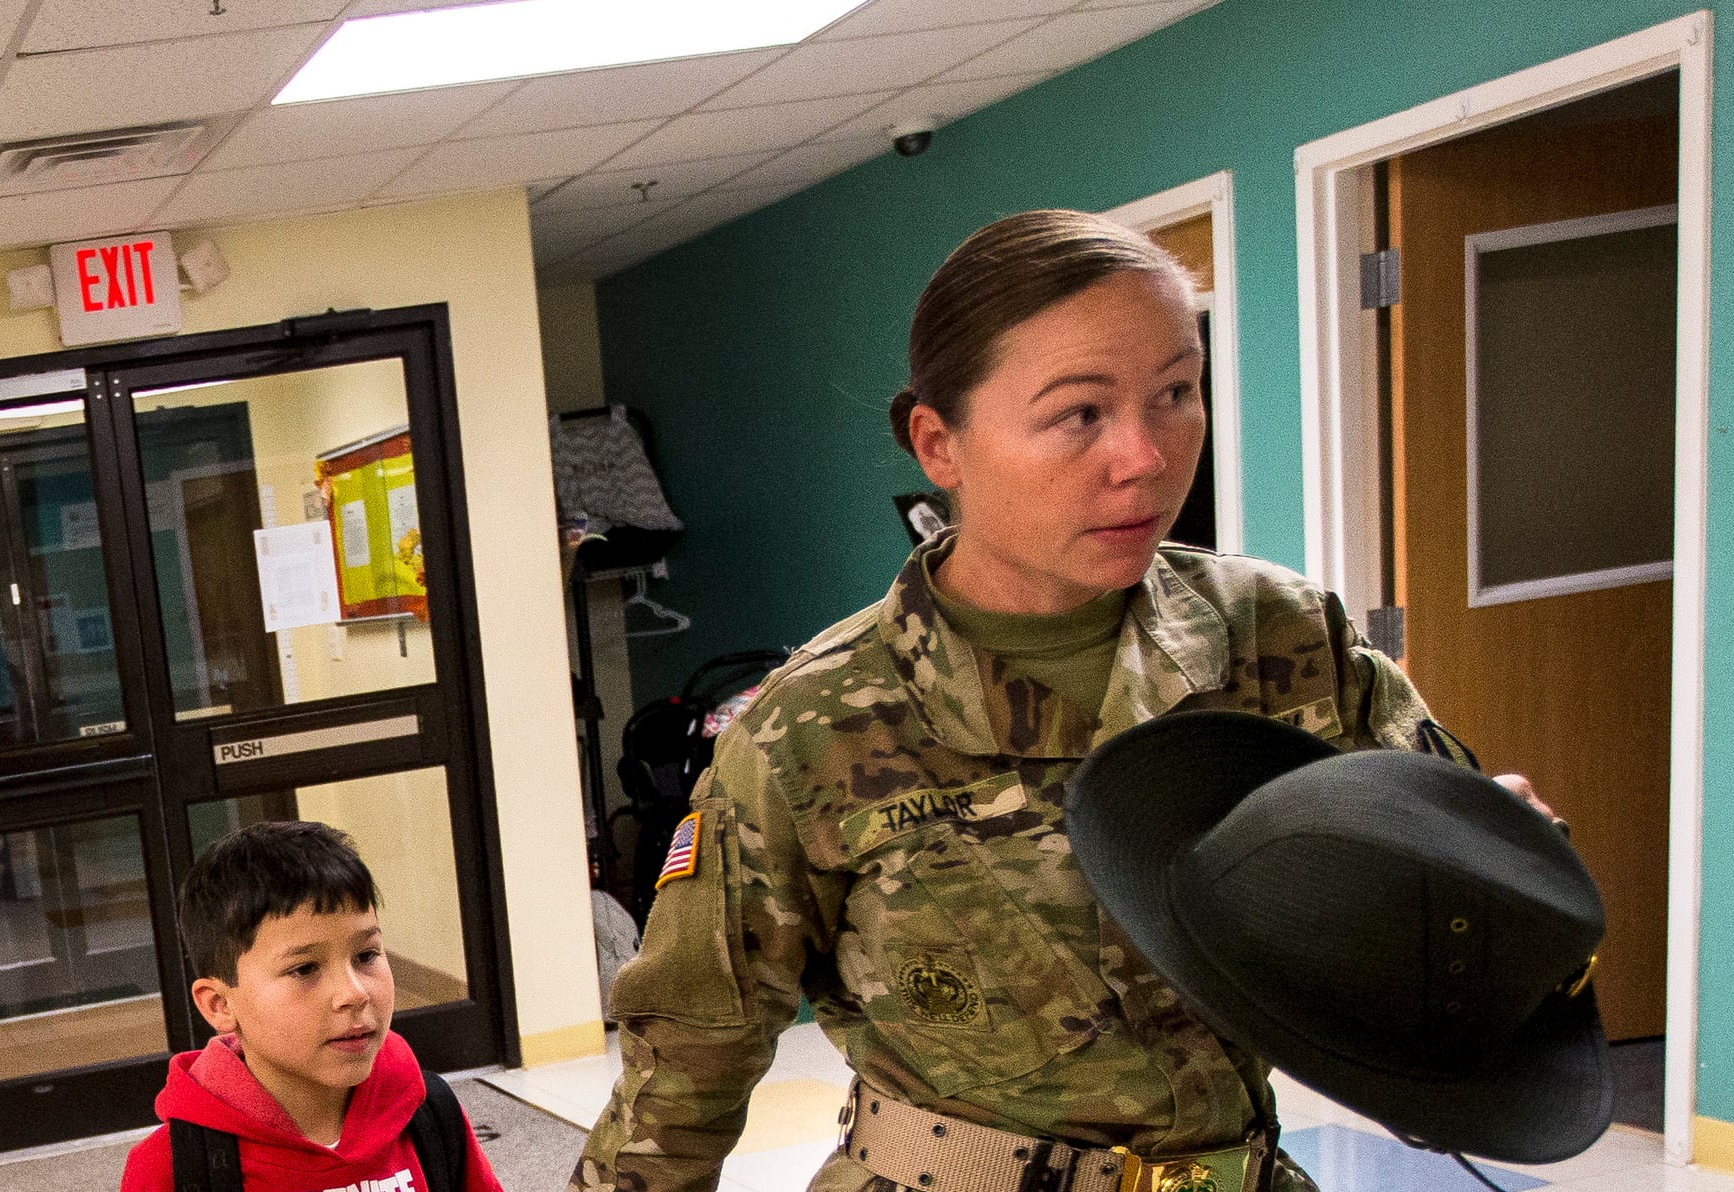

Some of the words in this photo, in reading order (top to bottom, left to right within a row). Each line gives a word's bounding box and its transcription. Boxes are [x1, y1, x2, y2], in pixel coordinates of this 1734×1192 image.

[76, 241, 155, 313] EXIT
[220, 741, 264, 761] PUSH
[877, 790, 978, 832] TAYLOR
